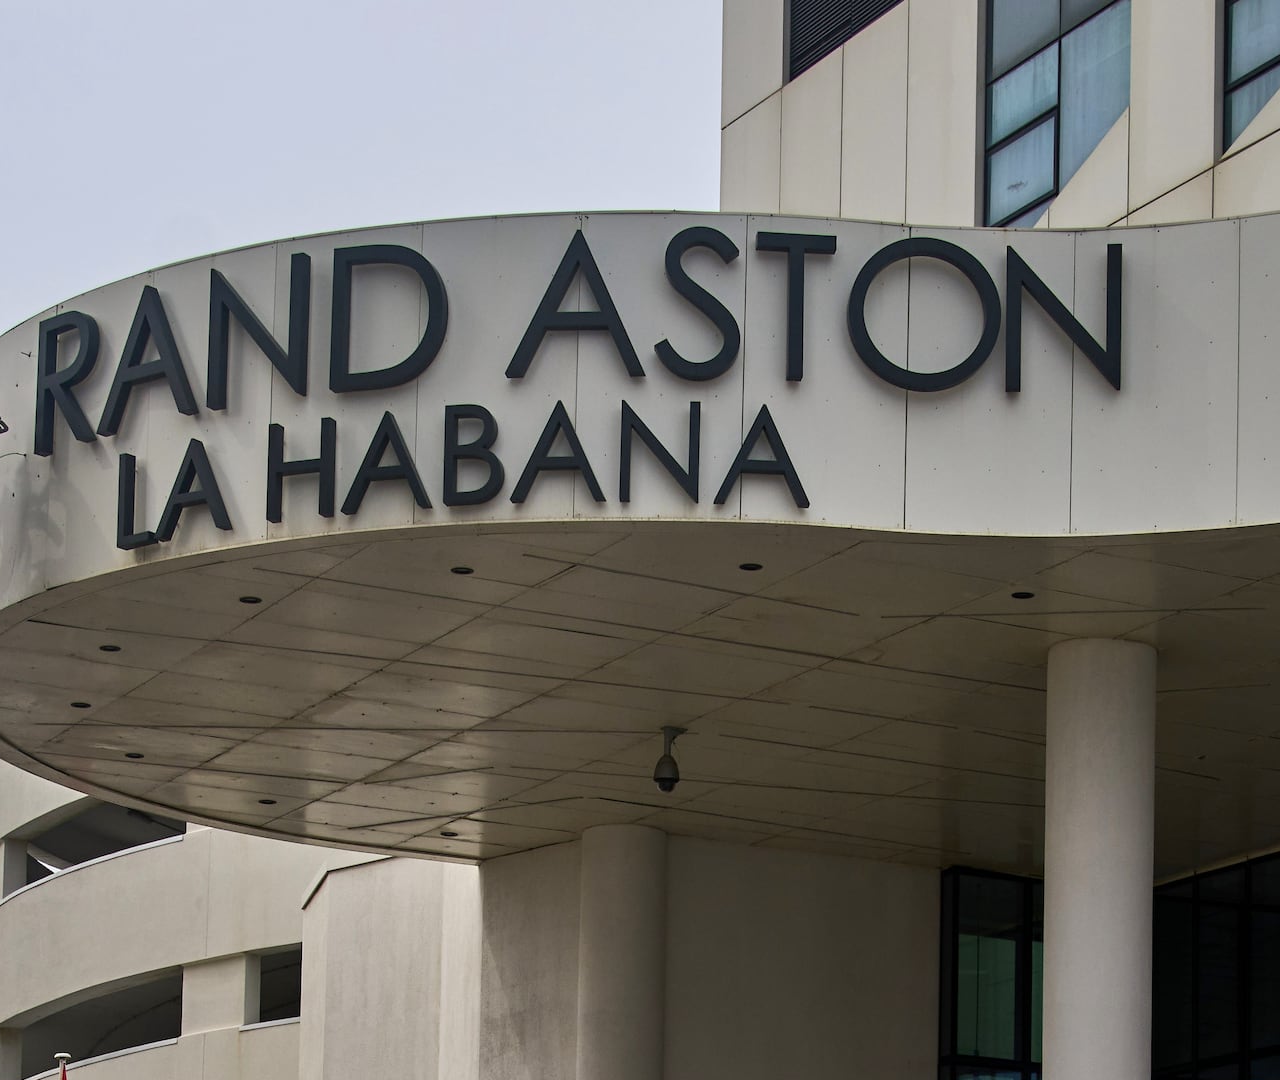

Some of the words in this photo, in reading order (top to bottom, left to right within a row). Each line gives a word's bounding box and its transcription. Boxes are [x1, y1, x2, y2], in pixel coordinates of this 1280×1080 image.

[33, 243, 450, 458] RAND
[504, 226, 1124, 394] ASTON
[116, 438, 234, 552] LA
[265, 400, 811, 523] HABANA
